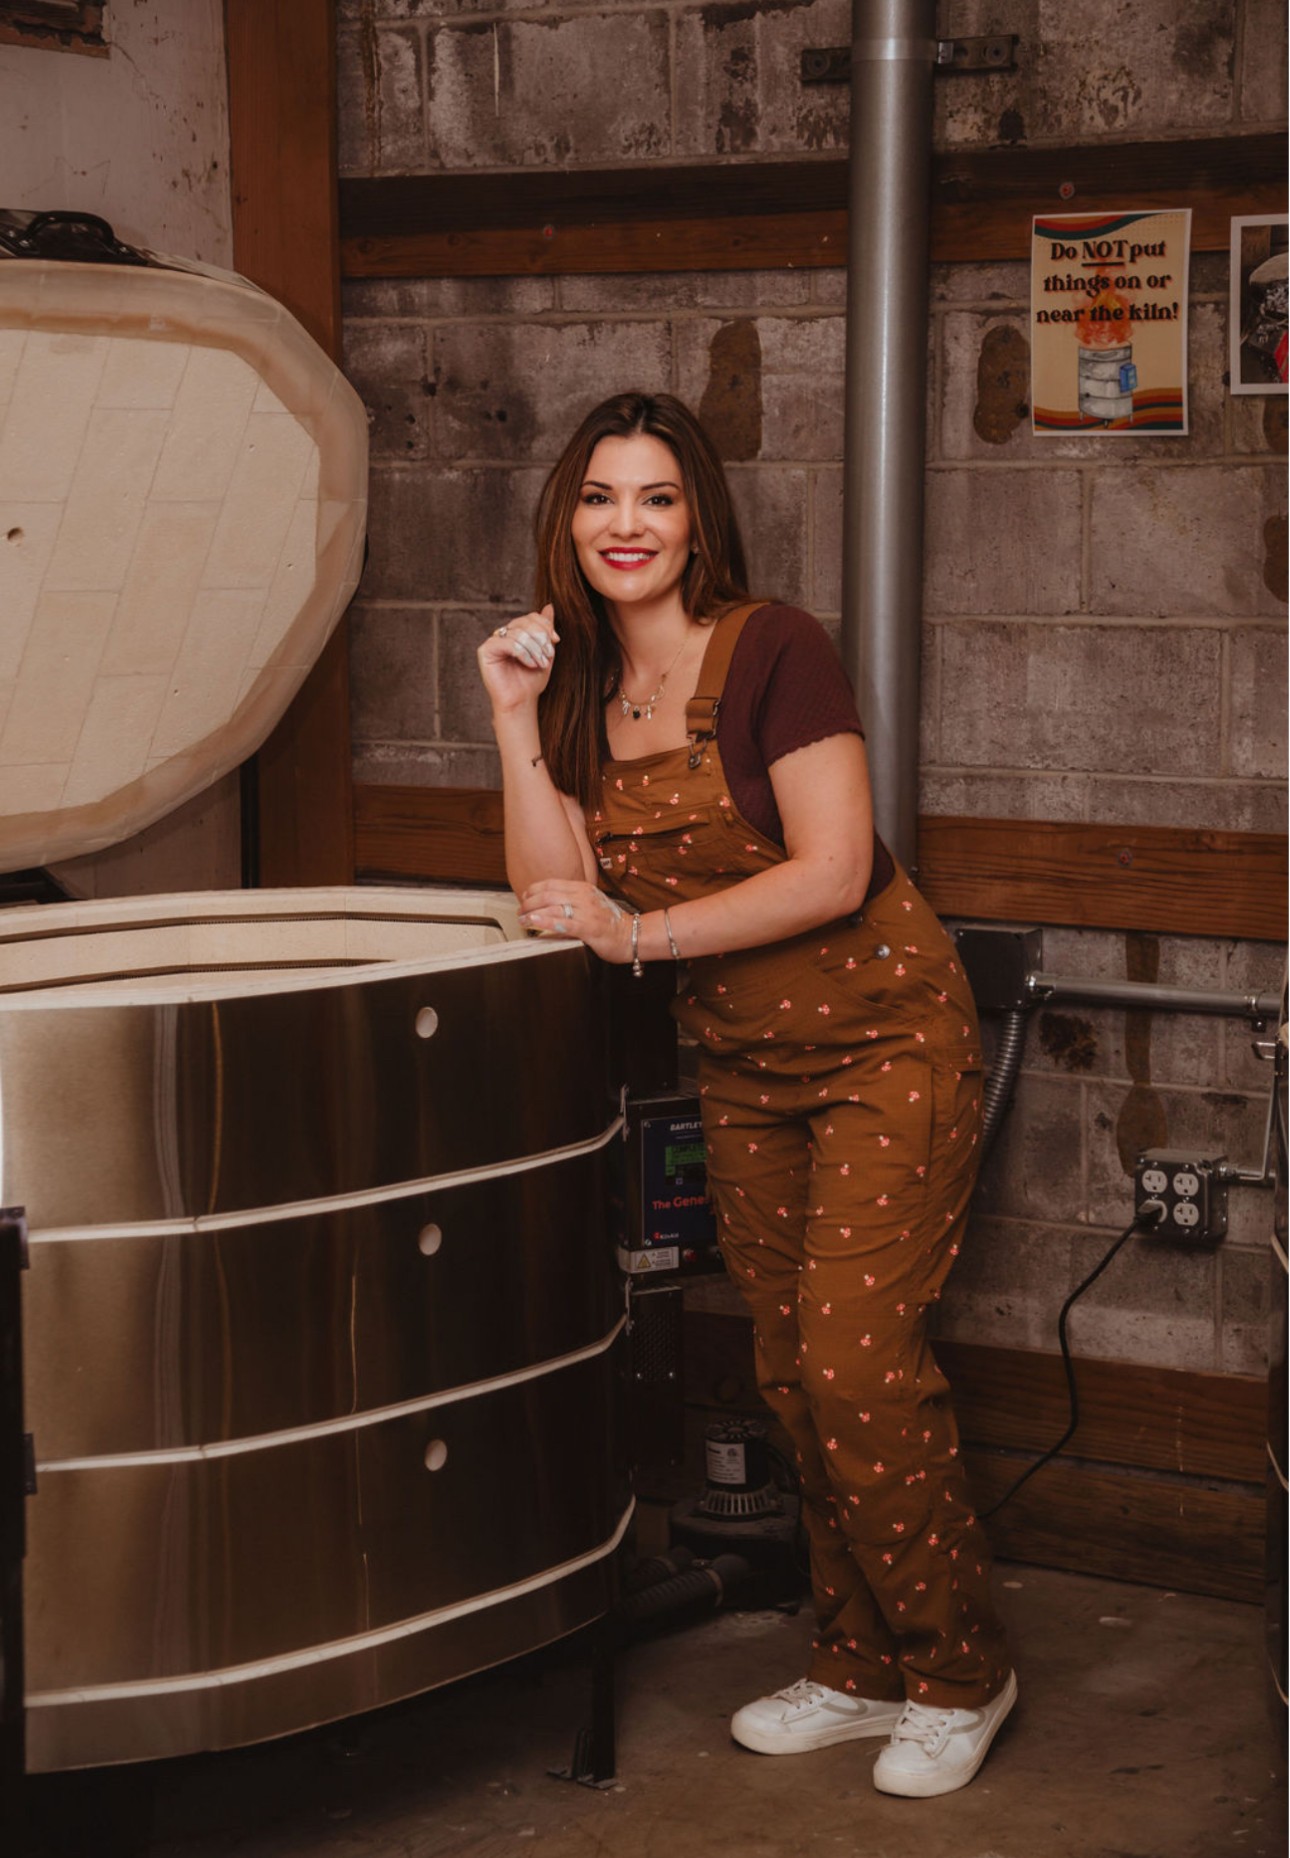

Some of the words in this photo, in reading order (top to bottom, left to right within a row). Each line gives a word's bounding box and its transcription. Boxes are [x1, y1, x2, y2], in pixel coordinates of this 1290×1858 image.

[1051, 242, 1077, 260] Do
[1082, 240, 1128, 259] NOT
[1129, 240, 1166, 263] put
[1044, 274, 1110, 298] things
[1114, 275, 1141, 289] on
[1146, 274, 1172, 288] or
[1036, 308, 1085, 323] near
[1090, 304, 1124, 321] the
[1129, 302, 1179, 321] kiln!
[670, 1121, 703, 1131] BARTLET
[652, 1199, 671, 1210] The
[673, 1196, 706, 1208] Gene
